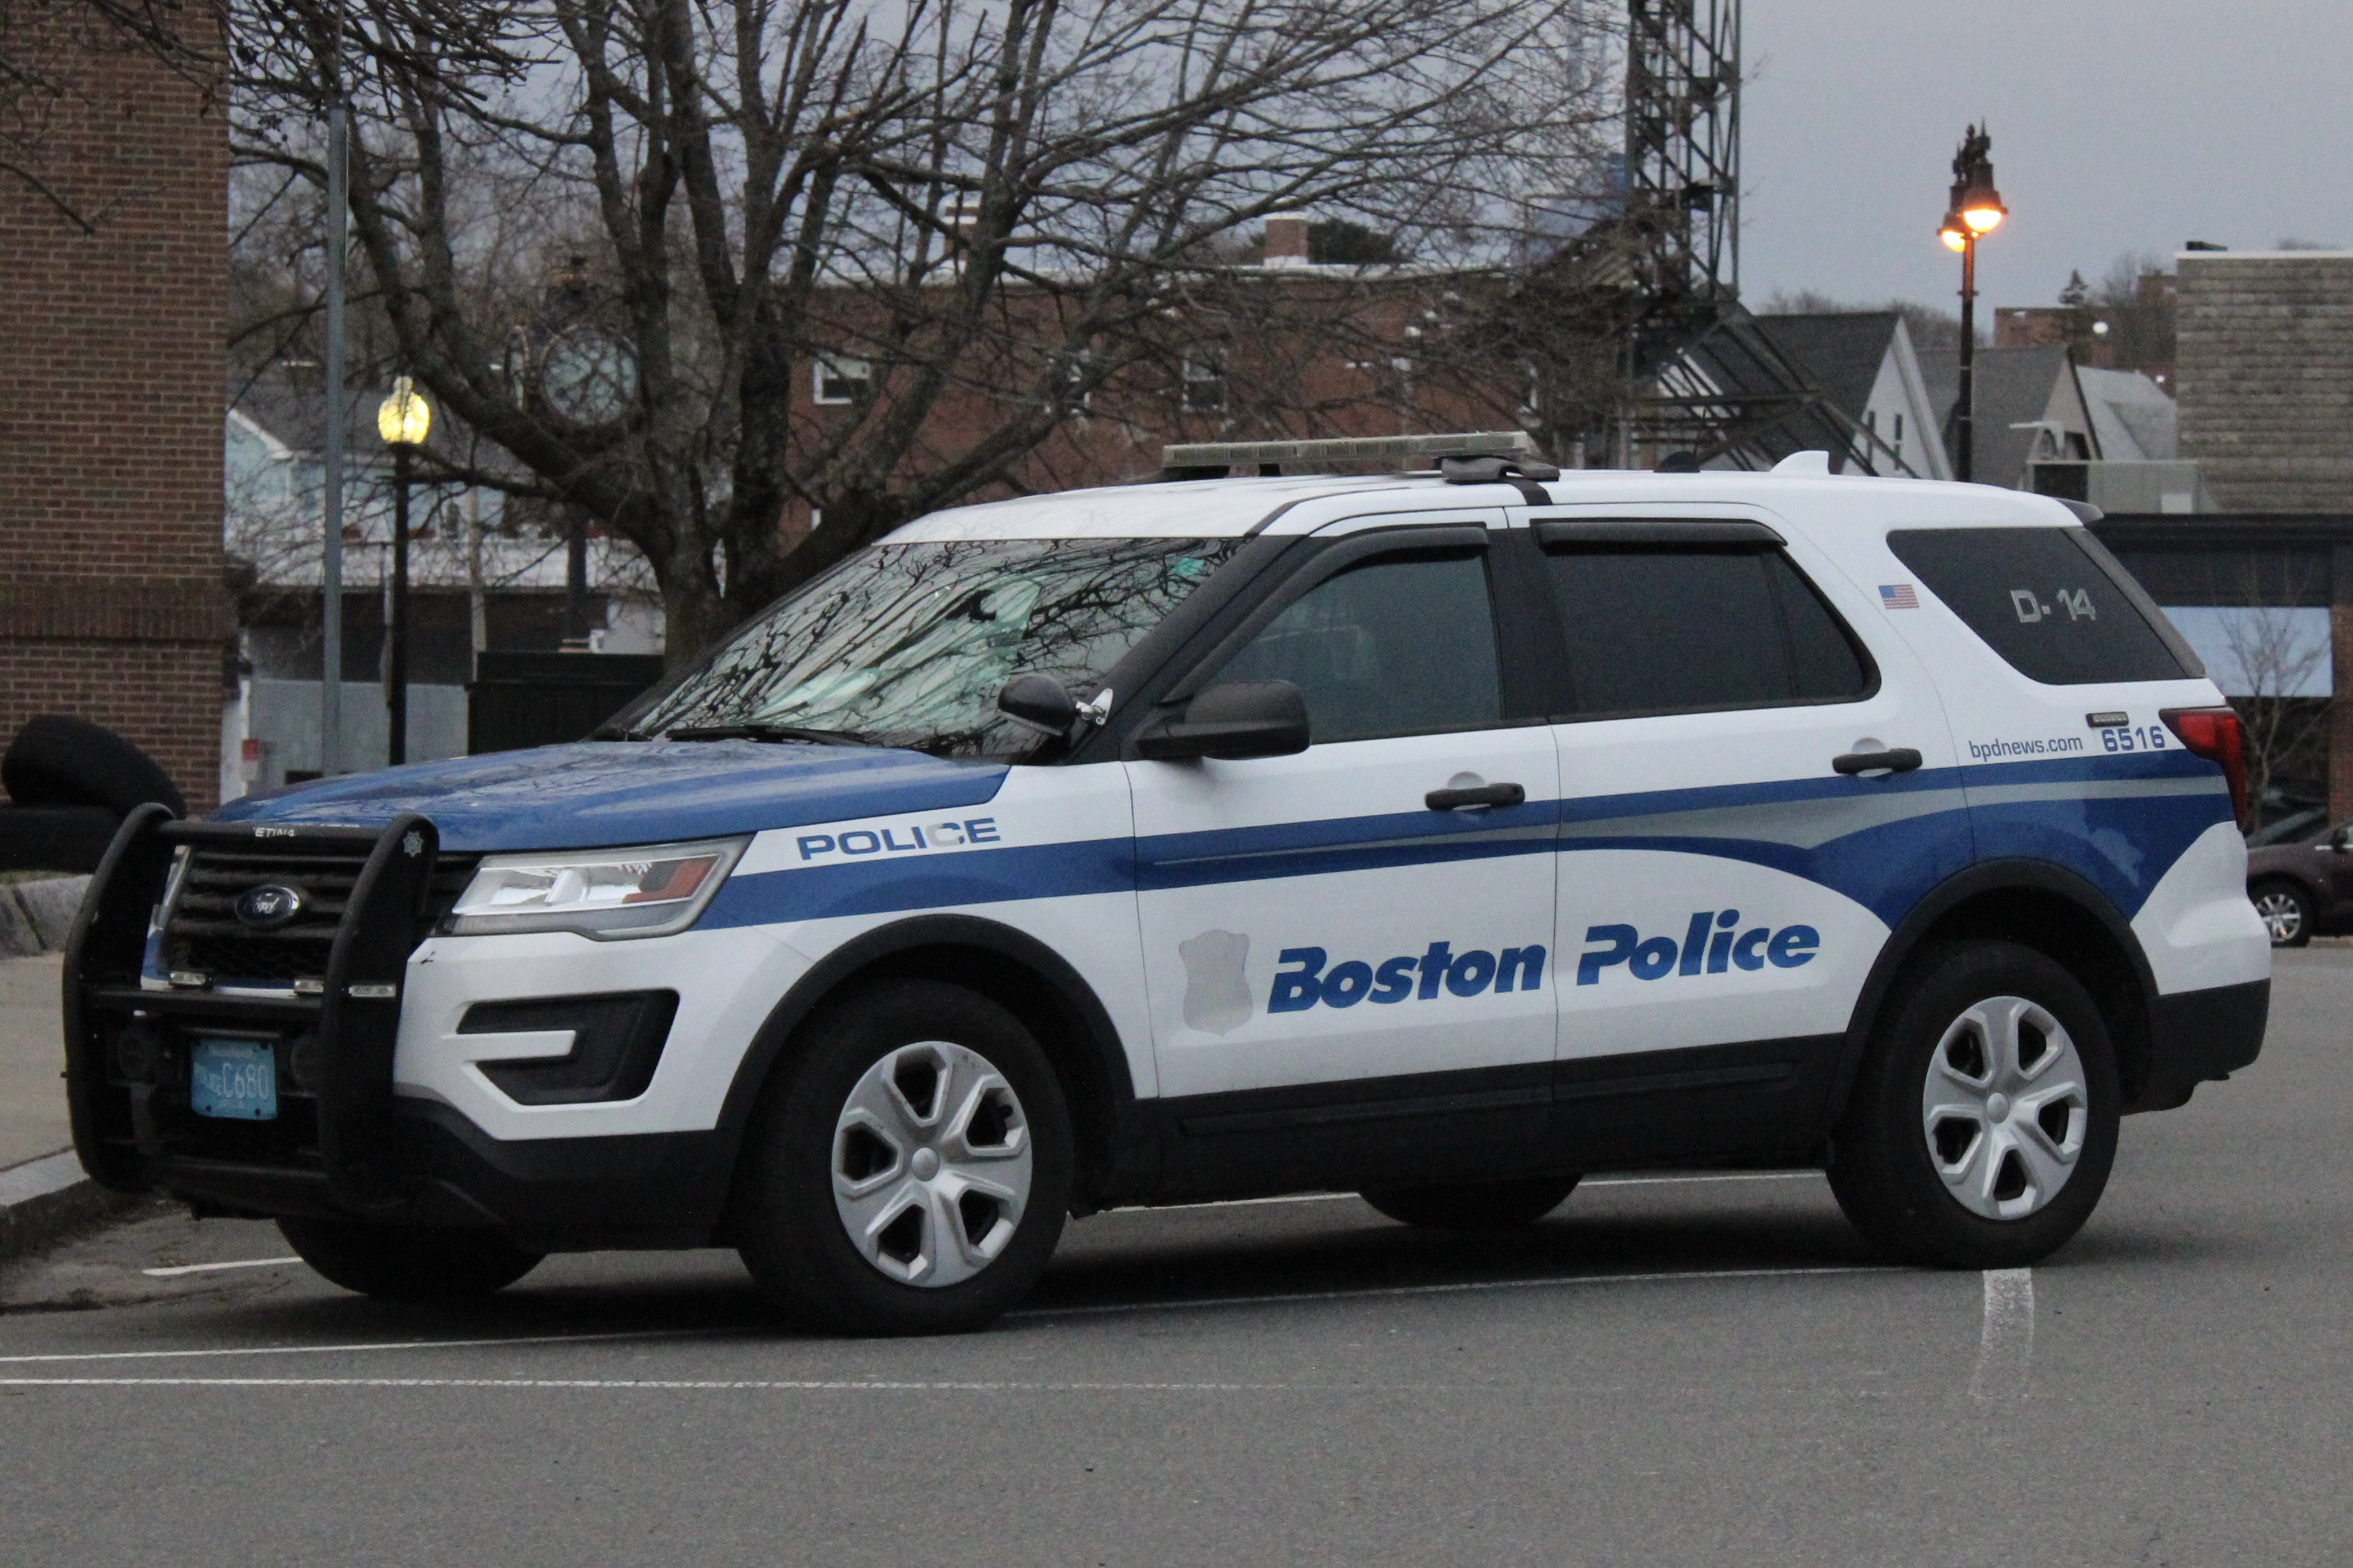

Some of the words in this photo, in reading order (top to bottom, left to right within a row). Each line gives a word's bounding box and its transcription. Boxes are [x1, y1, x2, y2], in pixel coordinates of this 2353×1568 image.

[1969, 735, 2084, 761] bpdnews.com
[2101, 725, 2166, 752] 6516
[796, 817, 1001, 861] POLICE
[1266, 940, 1546, 1014] Boston
[1577, 908, 1820, 986] Police
